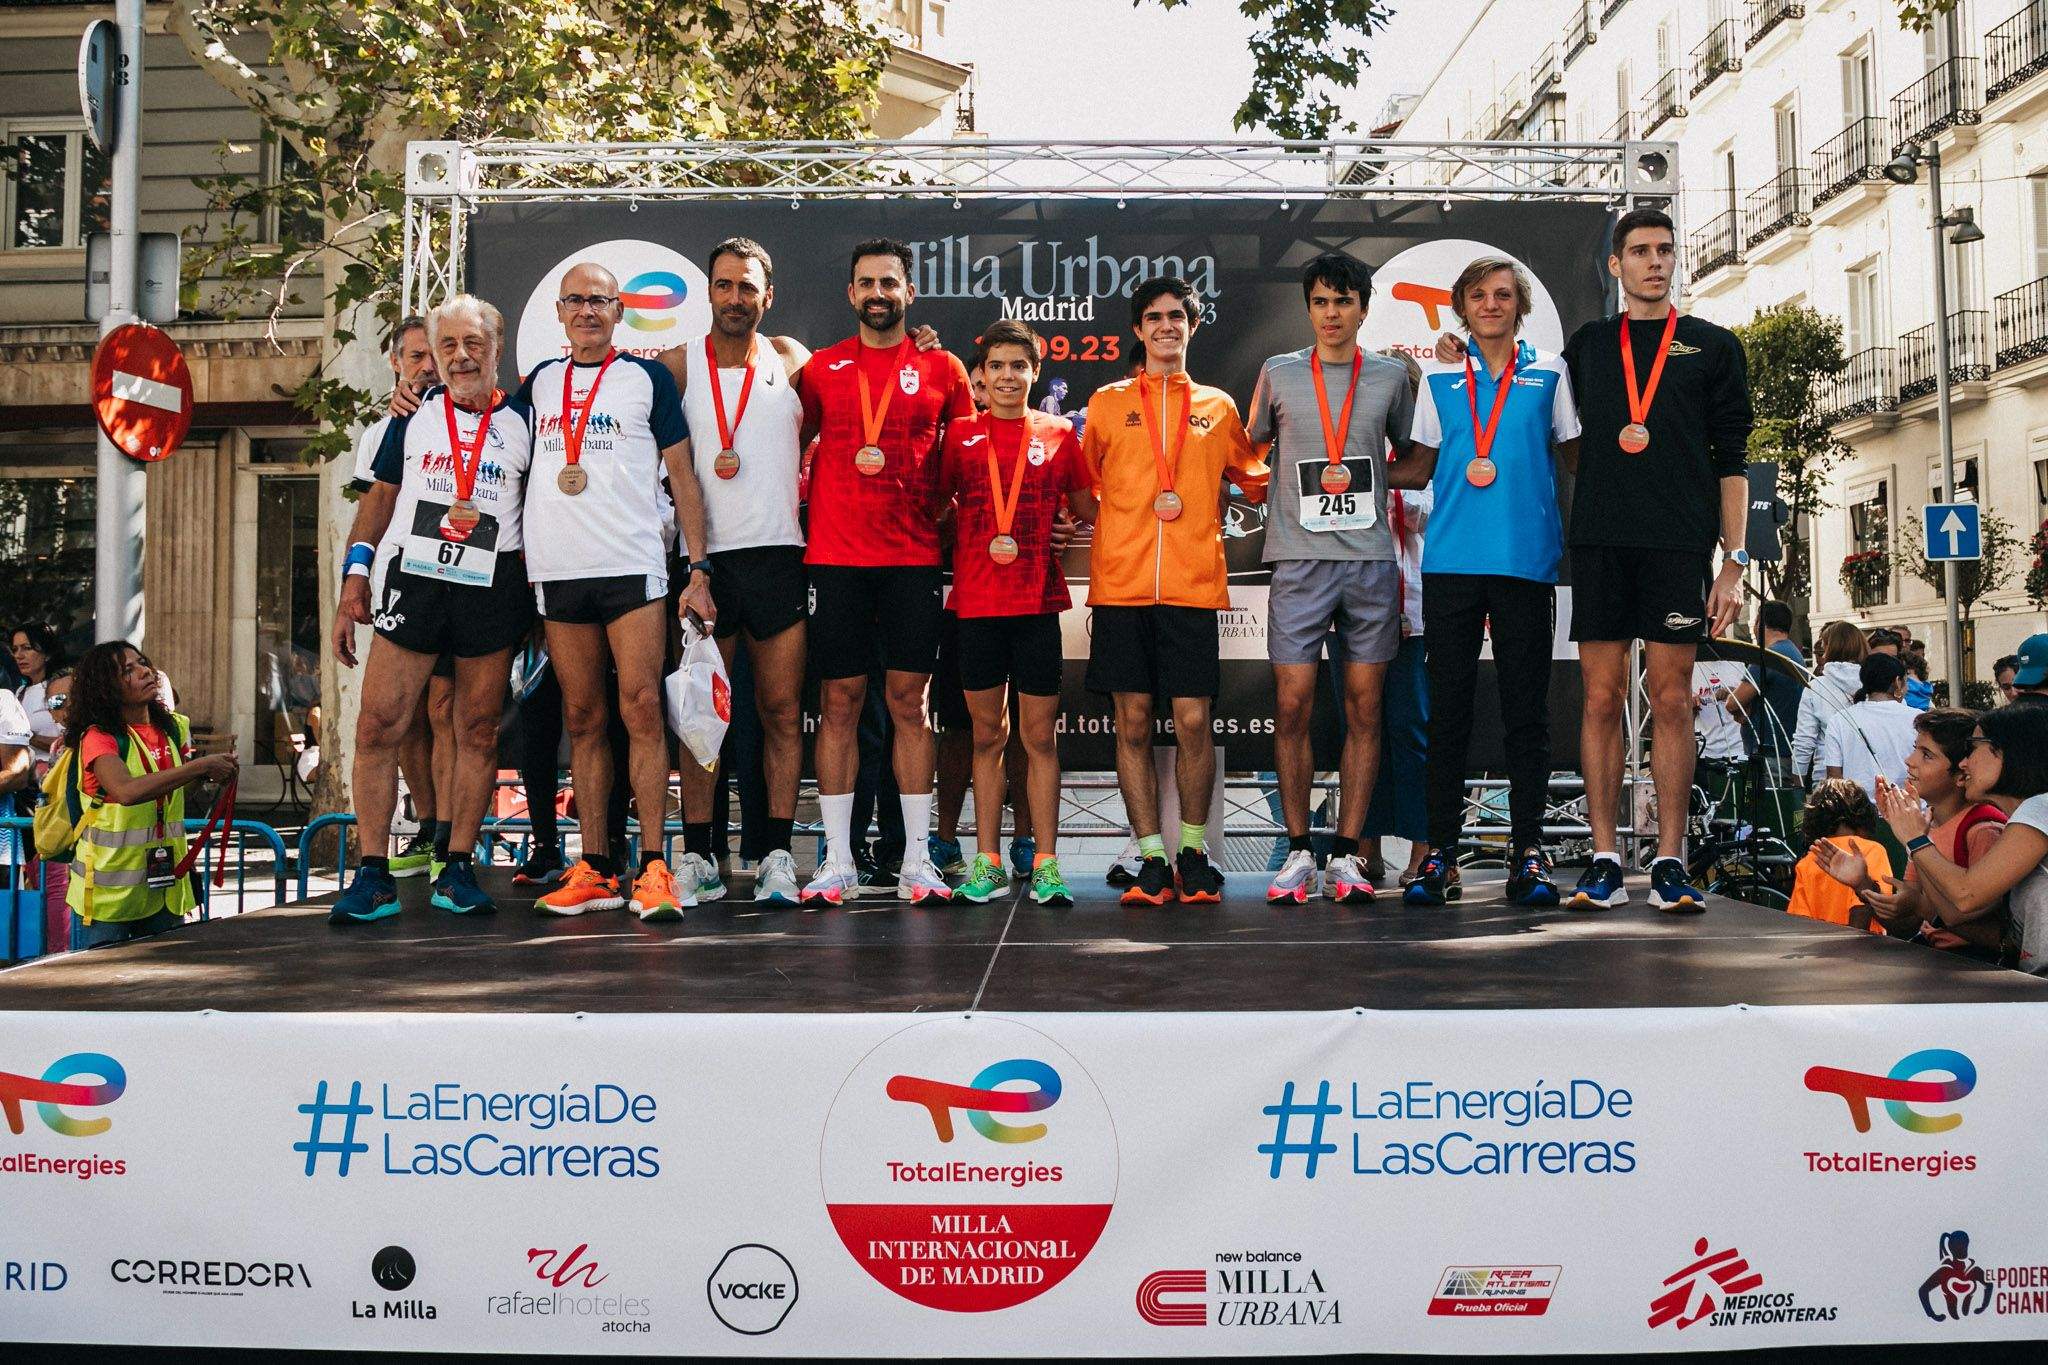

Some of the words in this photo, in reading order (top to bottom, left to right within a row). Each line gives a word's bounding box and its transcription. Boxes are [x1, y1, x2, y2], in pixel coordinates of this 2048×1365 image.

[1018, 235, 1221, 299] Urbana
[1000, 295, 1094, 323] Madrid
[1319, 493, 1356, 517] 245
[437, 541, 466, 567] 67
[1220, 626, 1264, 638] RBANA
[384, 1133, 661, 1178] LasCarreras
[1353, 1131, 1637, 1175] LasCarreras
[1803, 1150, 1977, 1177] TotalEnergies
[887, 1160, 1064, 1188] TotalEnergies
[931, 1215, 1013, 1234] MILLA
[1215, 1252, 1243, 1263] new
[1245, 1251, 1302, 1263] balance
[900, 1266, 936, 1285] DE
[943, 1266, 1044, 1285] MADRID
[1217, 1269, 1327, 1294] MILLA
[1485, 1280, 1551, 1288] ATLETISMO
[1986, 1269, 1996, 1281] EL
[717, 1280, 786, 1300] VOCKE
[352, 1301, 376, 1319] La
[384, 1300, 437, 1319] Milla
[1454, 1303, 1491, 1312] Prueba
[1494, 1302, 1528, 1312] Oficial
[1723, 1293, 1794, 1311] MEDICOS
[1996, 1290, 2048, 1315] CHAN
[1217, 1300, 1342, 1327] URBANA
[1709, 1312, 1736, 1327] SIN
[1742, 1306, 1838, 1324] FRONTERAS
[602, 1320, 651, 1333] atocha
